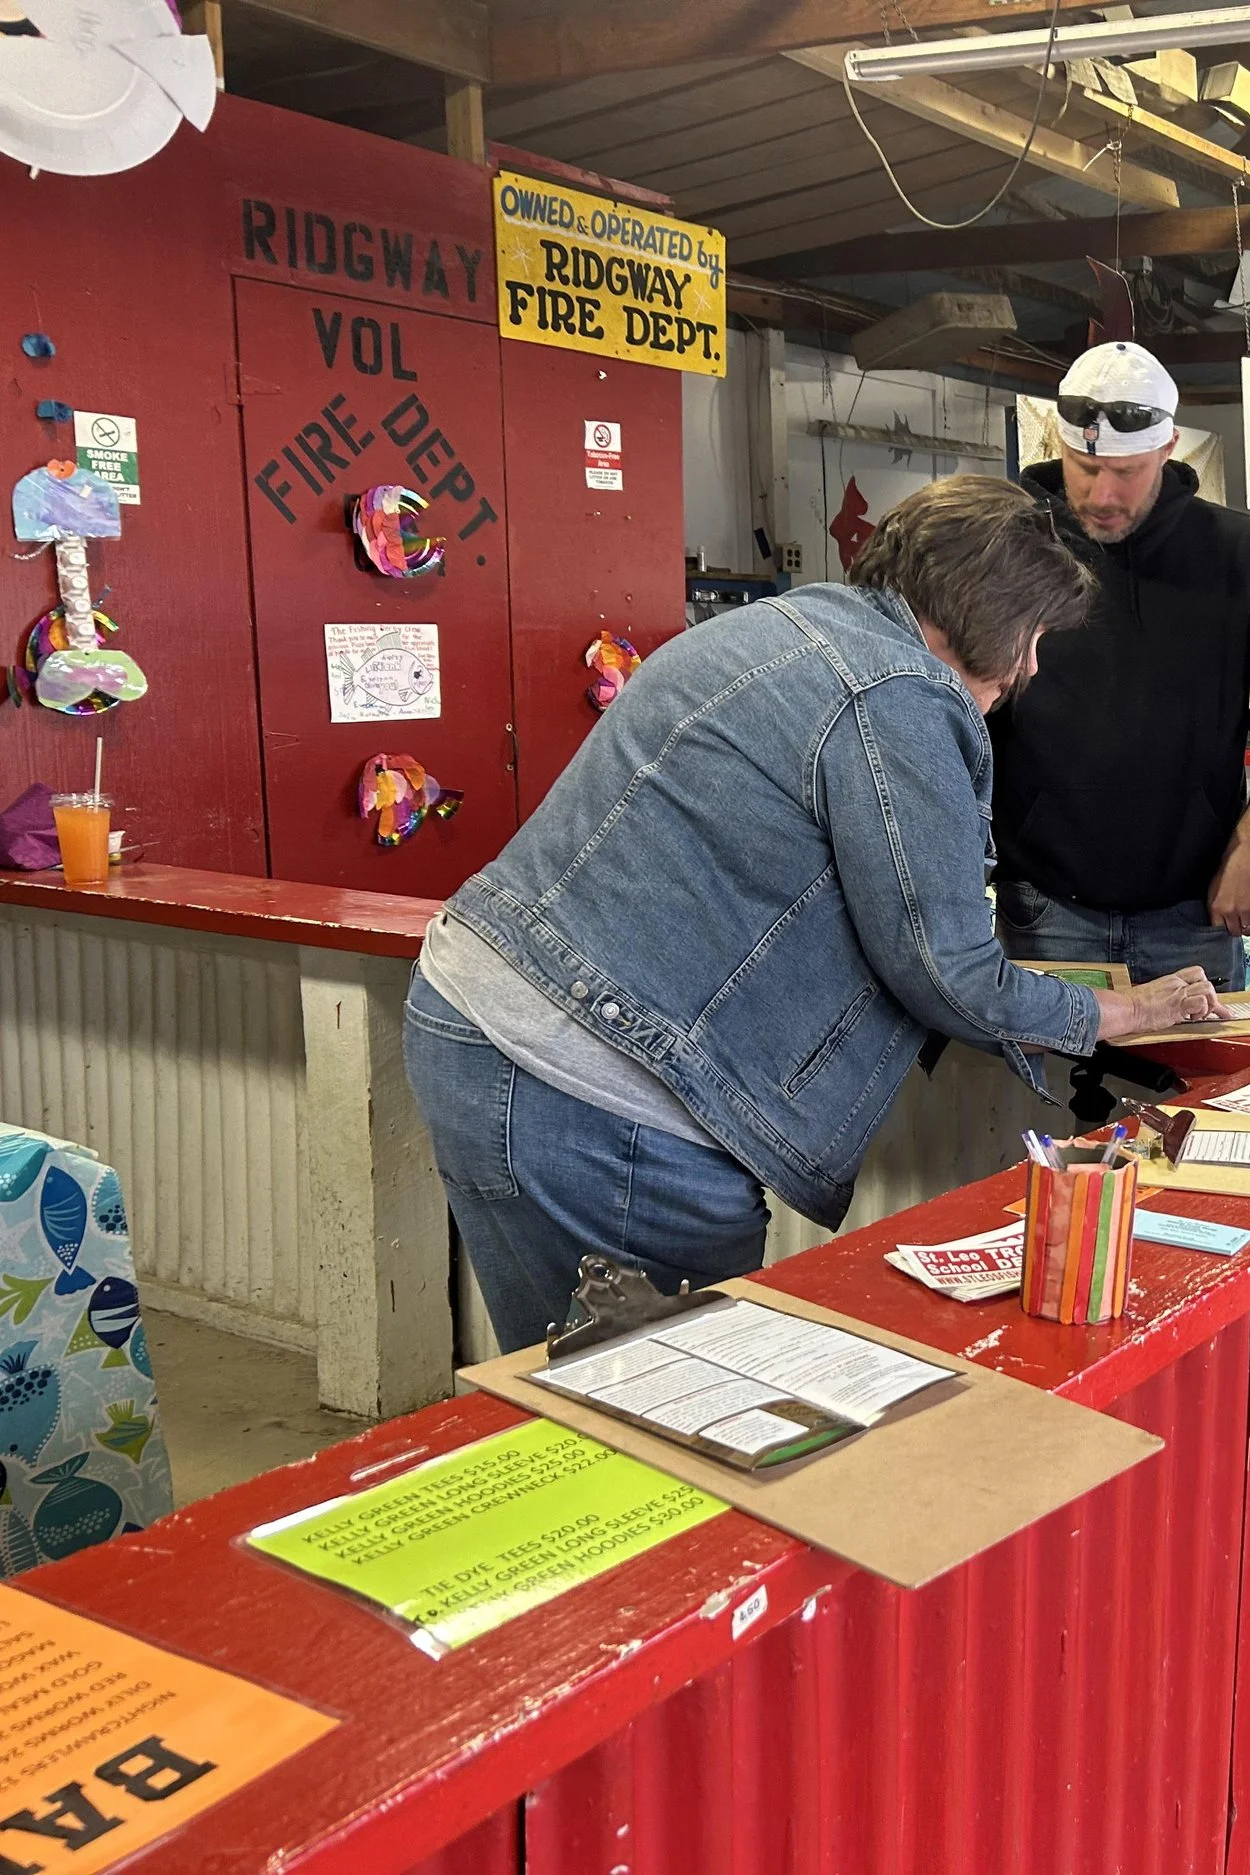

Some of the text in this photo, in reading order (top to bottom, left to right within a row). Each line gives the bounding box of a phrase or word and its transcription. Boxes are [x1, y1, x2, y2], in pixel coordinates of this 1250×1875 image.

[243, 199, 483, 303] RIDGWAY
[501, 184, 724, 290] OWNED & OPERATED by
[539, 238, 692, 311] RIDGWAY
[312, 307, 417, 382] VOL
[504, 279, 721, 361] FIRE DEPT.
[86, 448, 129, 463] SMOKE
[91, 460, 122, 472] FREE
[254, 392, 376, 525] FIRE
[917, 1251, 944, 1264] St.
[946, 1250, 981, 1263] Leo
[927, 1260, 989, 1276] School
[302, 1450, 520, 1544] KELLY GREEN TEES $15.00
[318, 1525, 371, 1551] KELLY
[374, 1498, 437, 1528] GREEN
[436, 1477, 488, 1501] LONG
[487, 1451, 548, 1479] SLEEVE
[334, 1449, 585, 1560] KELLY GREEN HOODIES $25.00
[351, 1539, 405, 1565] KELLY
[407, 1512, 471, 1542] GREEN
[470, 1472, 566, 1514] CREWNECK
[420, 1513, 600, 1598] TIE DYE TEES $20.00
[441, 1578, 492, 1608] KELLY
[495, 1549, 557, 1582] GREEN
[556, 1526, 607, 1553] LONG
[605, 1499, 665, 1530] SLEEVE
[513, 1495, 704, 1593] GREEN HOODIES $30.00
[10, 1671, 128, 1732] RED WORMS
[50, 1660, 102, 1688] GOLD
[20, 1690, 177, 1776] NIGHTCRAWLERS
[23, 1706, 105, 1748] WORMS
[0, 1735, 219, 1875] BA
